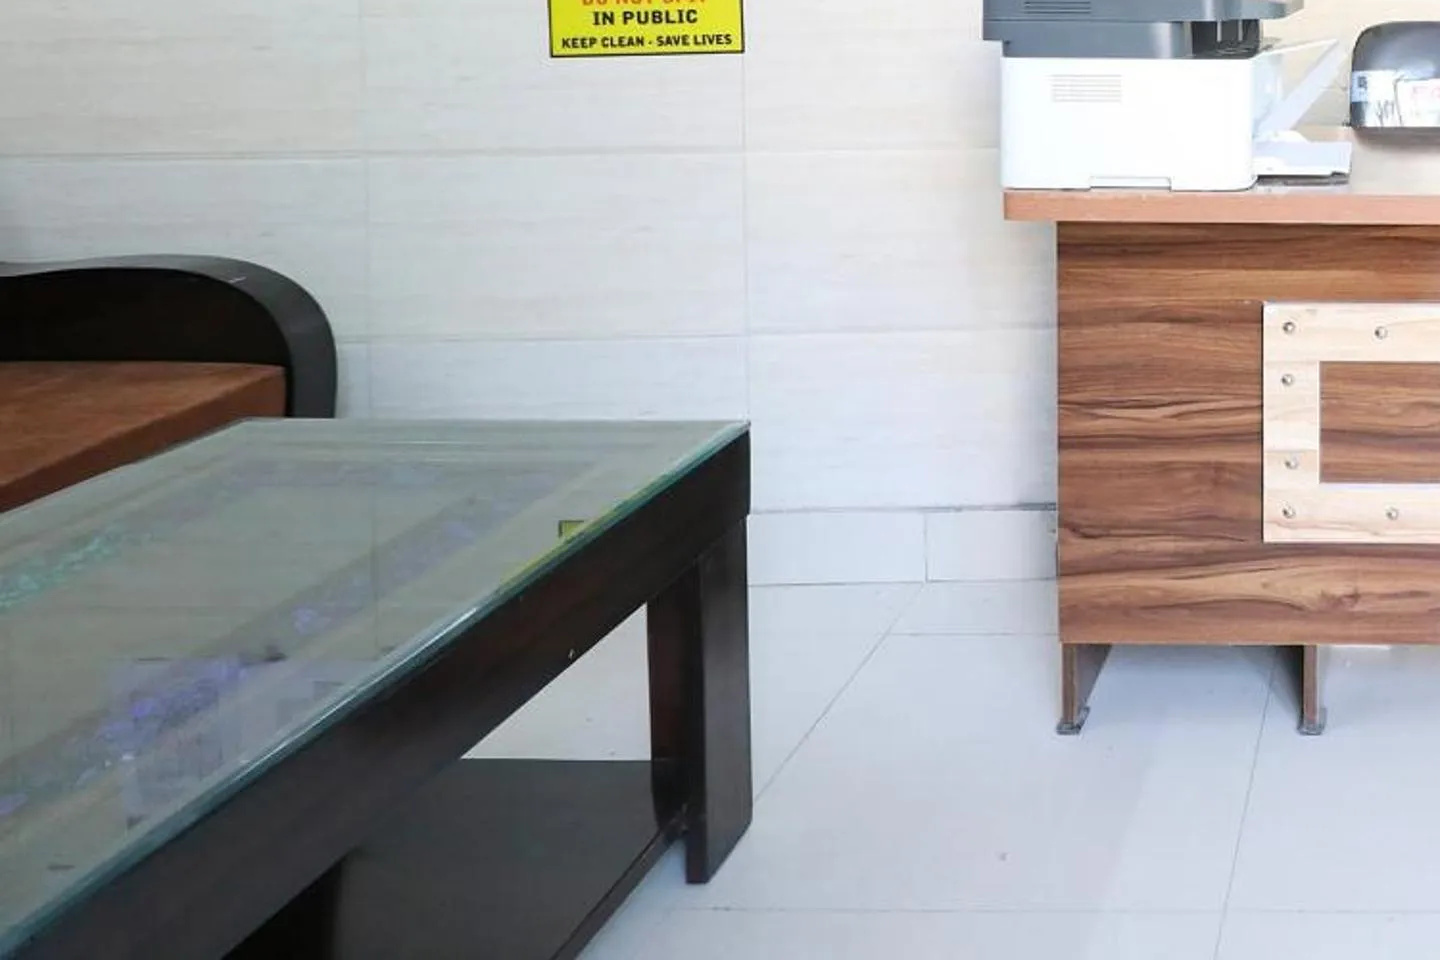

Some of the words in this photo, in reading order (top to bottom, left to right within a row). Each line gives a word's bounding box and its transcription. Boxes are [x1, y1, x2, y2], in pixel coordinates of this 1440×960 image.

[593, 12, 615, 25] IN
[623, 10, 698, 25] PUBLIC
[562, 37, 597, 49] KEEP
[601, 37, 644, 48] CLEAN
[656, 36, 690, 47] SAVE
[694, 34, 732, 46] LIVES
